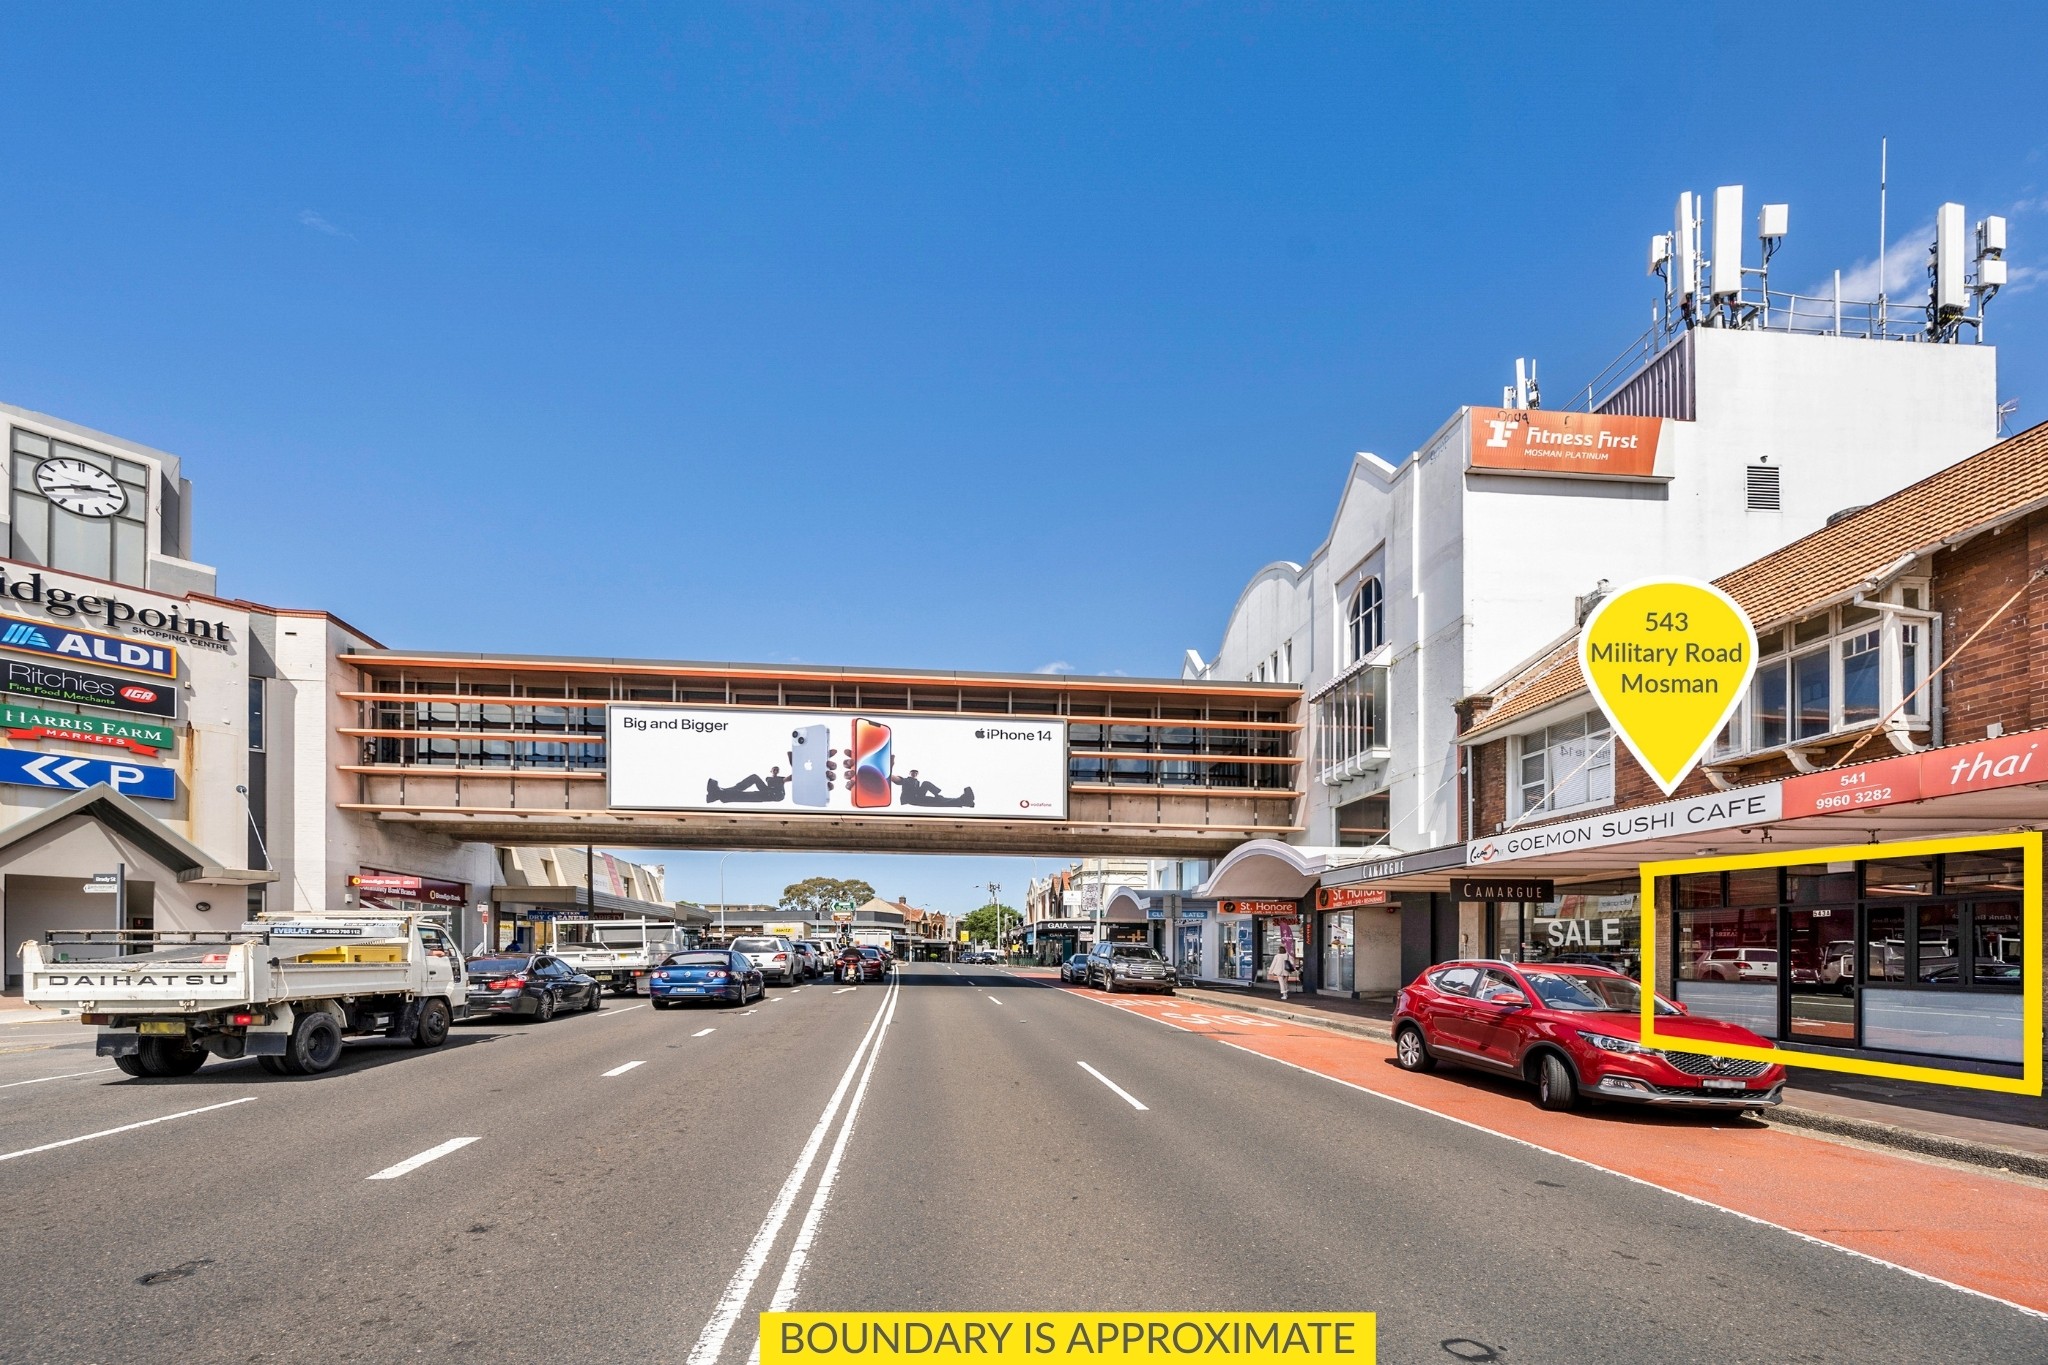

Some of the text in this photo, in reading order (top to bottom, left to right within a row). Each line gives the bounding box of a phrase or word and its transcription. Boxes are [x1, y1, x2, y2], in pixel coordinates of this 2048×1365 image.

[1526, 426, 1639, 449] Fitness First
[1523, 448, 1609, 461] MOSMAN PLATINUM
[132, 626, 229, 652] SHOPPING CENTRE
[56, 633, 164, 670] ALDI
[9, 663, 115, 697] Ritchies
[9, 682, 116, 705] Fine Food Merchants
[124, 688, 153, 701] IGA
[6, 709, 162, 742] HARRIS FARM
[623, 717, 729, 733] Big and Bigger
[987, 728, 1052, 741] iPhone 14
[46, 729, 126, 745] MARKETS
[1950, 743, 2039, 785] thai
[110, 764, 145, 792] P
[1840, 772, 1866, 787] 541
[1816, 787, 1892, 810] 9960 3282
[1507, 826, 1592, 853] GOEMON
[1602, 811, 1674, 838] SUSHI
[1687, 795, 1766, 824] CAFE
[1362, 860, 1404, 879] CAMARGUE
[1463, 883, 1542, 898] CAMARGUE
[1240, 902, 1253, 911] St.
[1547, 918, 1622, 947] SALE
[49, 974, 229, 986] DAIHATSU
